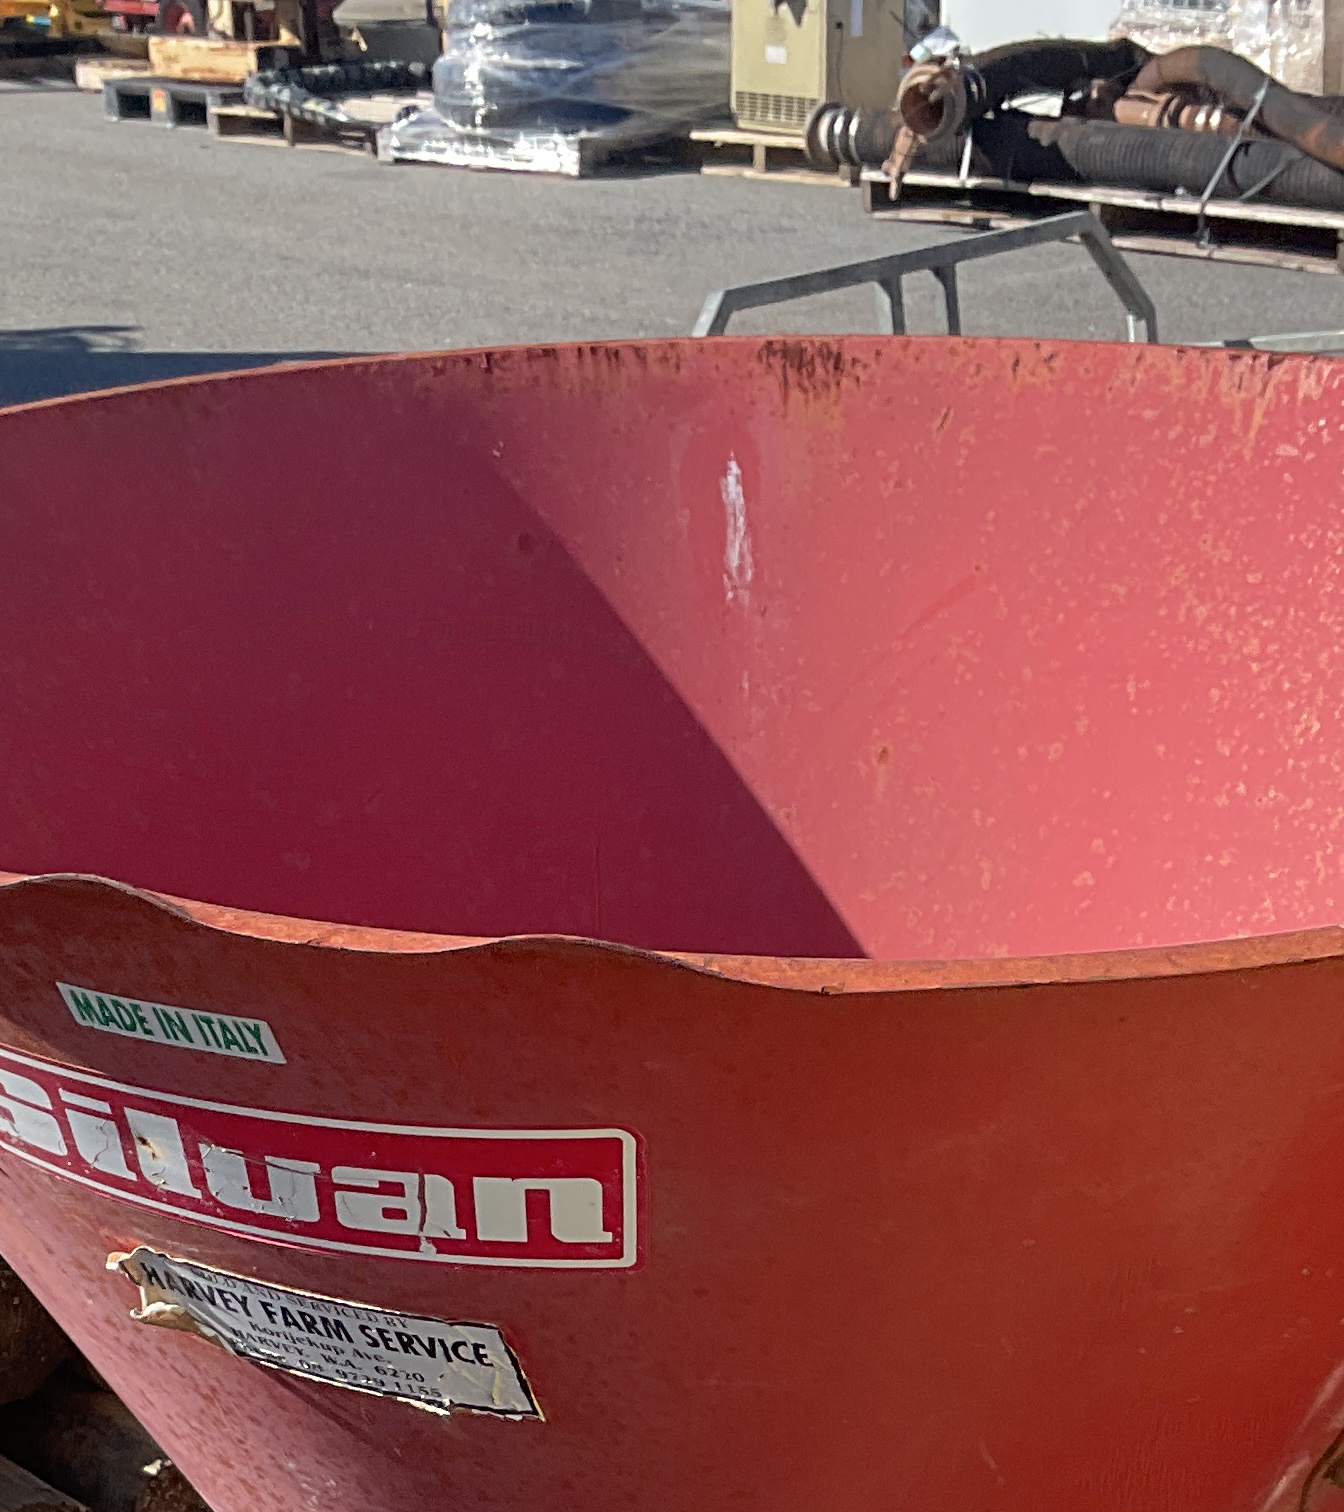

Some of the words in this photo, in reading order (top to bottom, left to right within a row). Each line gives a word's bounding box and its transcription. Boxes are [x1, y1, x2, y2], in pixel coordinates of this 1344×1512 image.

[70, 989, 154, 1036] MADE
[153, 1006, 194, 1043] IN
[191, 1013, 268, 1057] ITALY
[139, 1261, 253, 1318] HARVEY
[258, 1299, 355, 1344] FARM
[358, 1323, 494, 1368] SERVICE
[243, 1283, 281, 1301] AND
[286, 1291, 379, 1323] SERVICED
[383, 1315, 408, 1329] BY
[321, 1353, 362, 1371] W.A.
[393, 1380, 442, 1398] 1155
